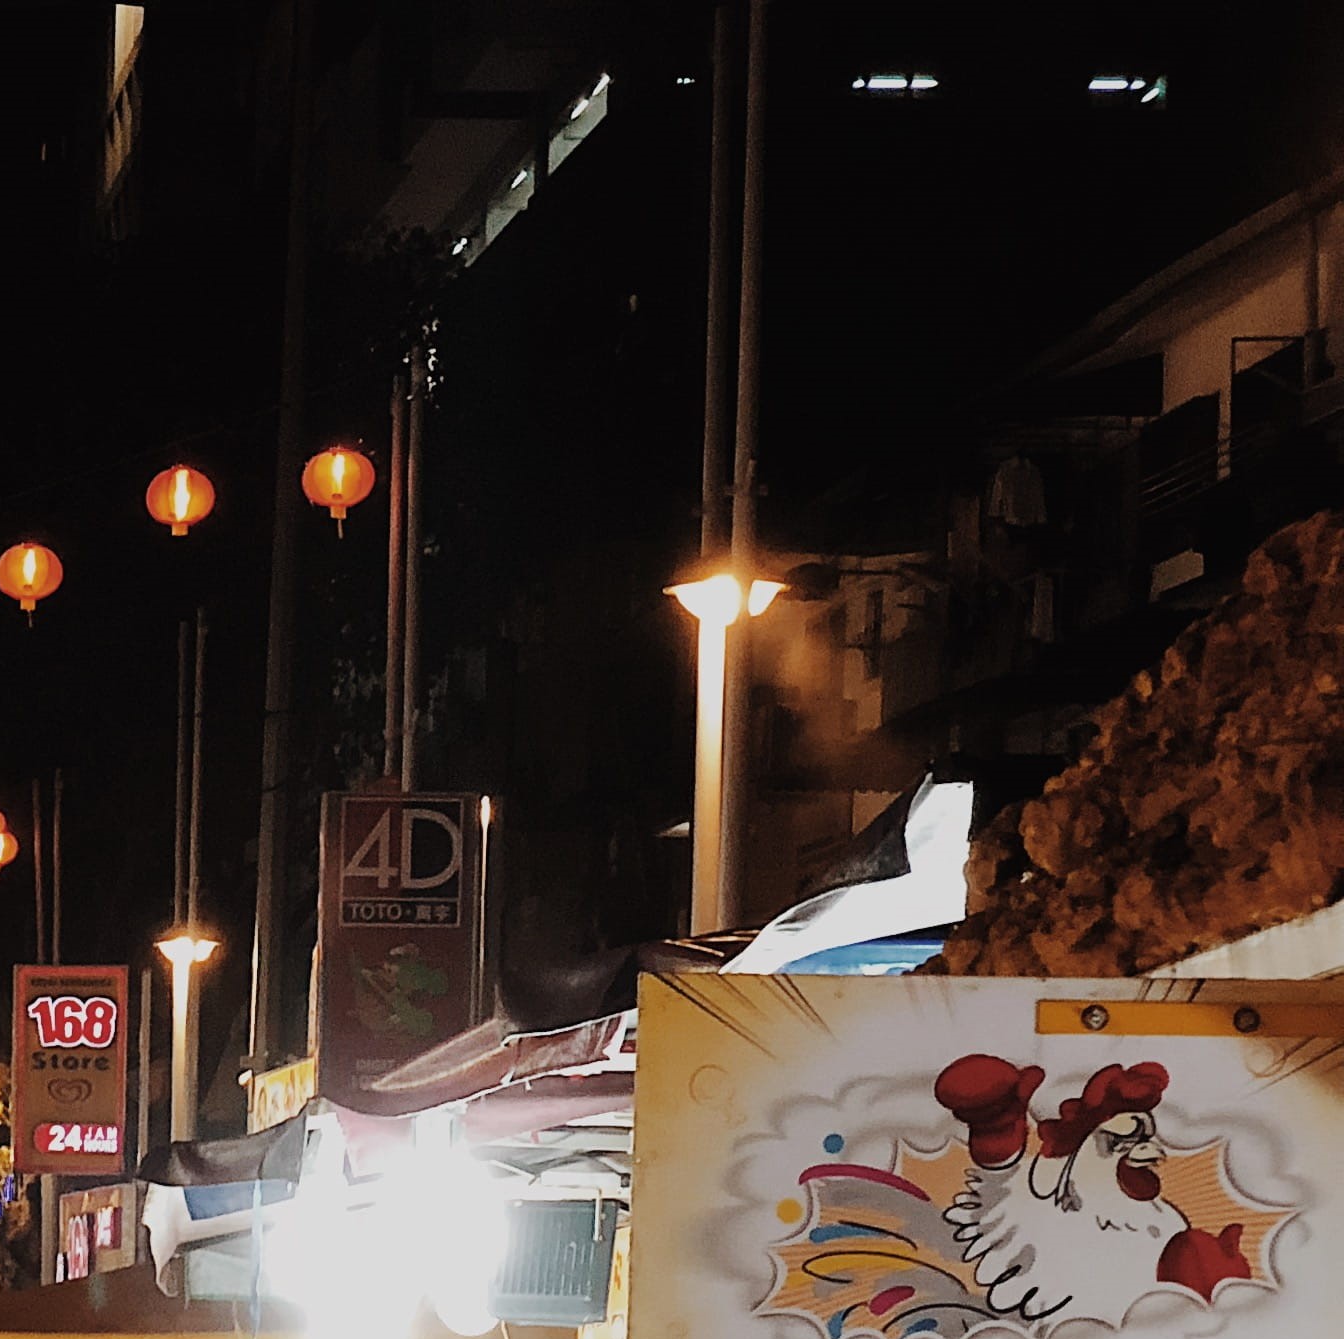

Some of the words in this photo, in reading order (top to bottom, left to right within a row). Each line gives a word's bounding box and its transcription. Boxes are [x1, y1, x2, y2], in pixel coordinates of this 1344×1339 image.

[343, 807, 461, 890] 4D
[348, 901, 402, 922] TOTO
[28, 996, 117, 1049] 168
[31, 1050, 111, 1072] Store
[48, 1124, 83, 1152] 24
[84, 1126, 118, 1141] JAM
